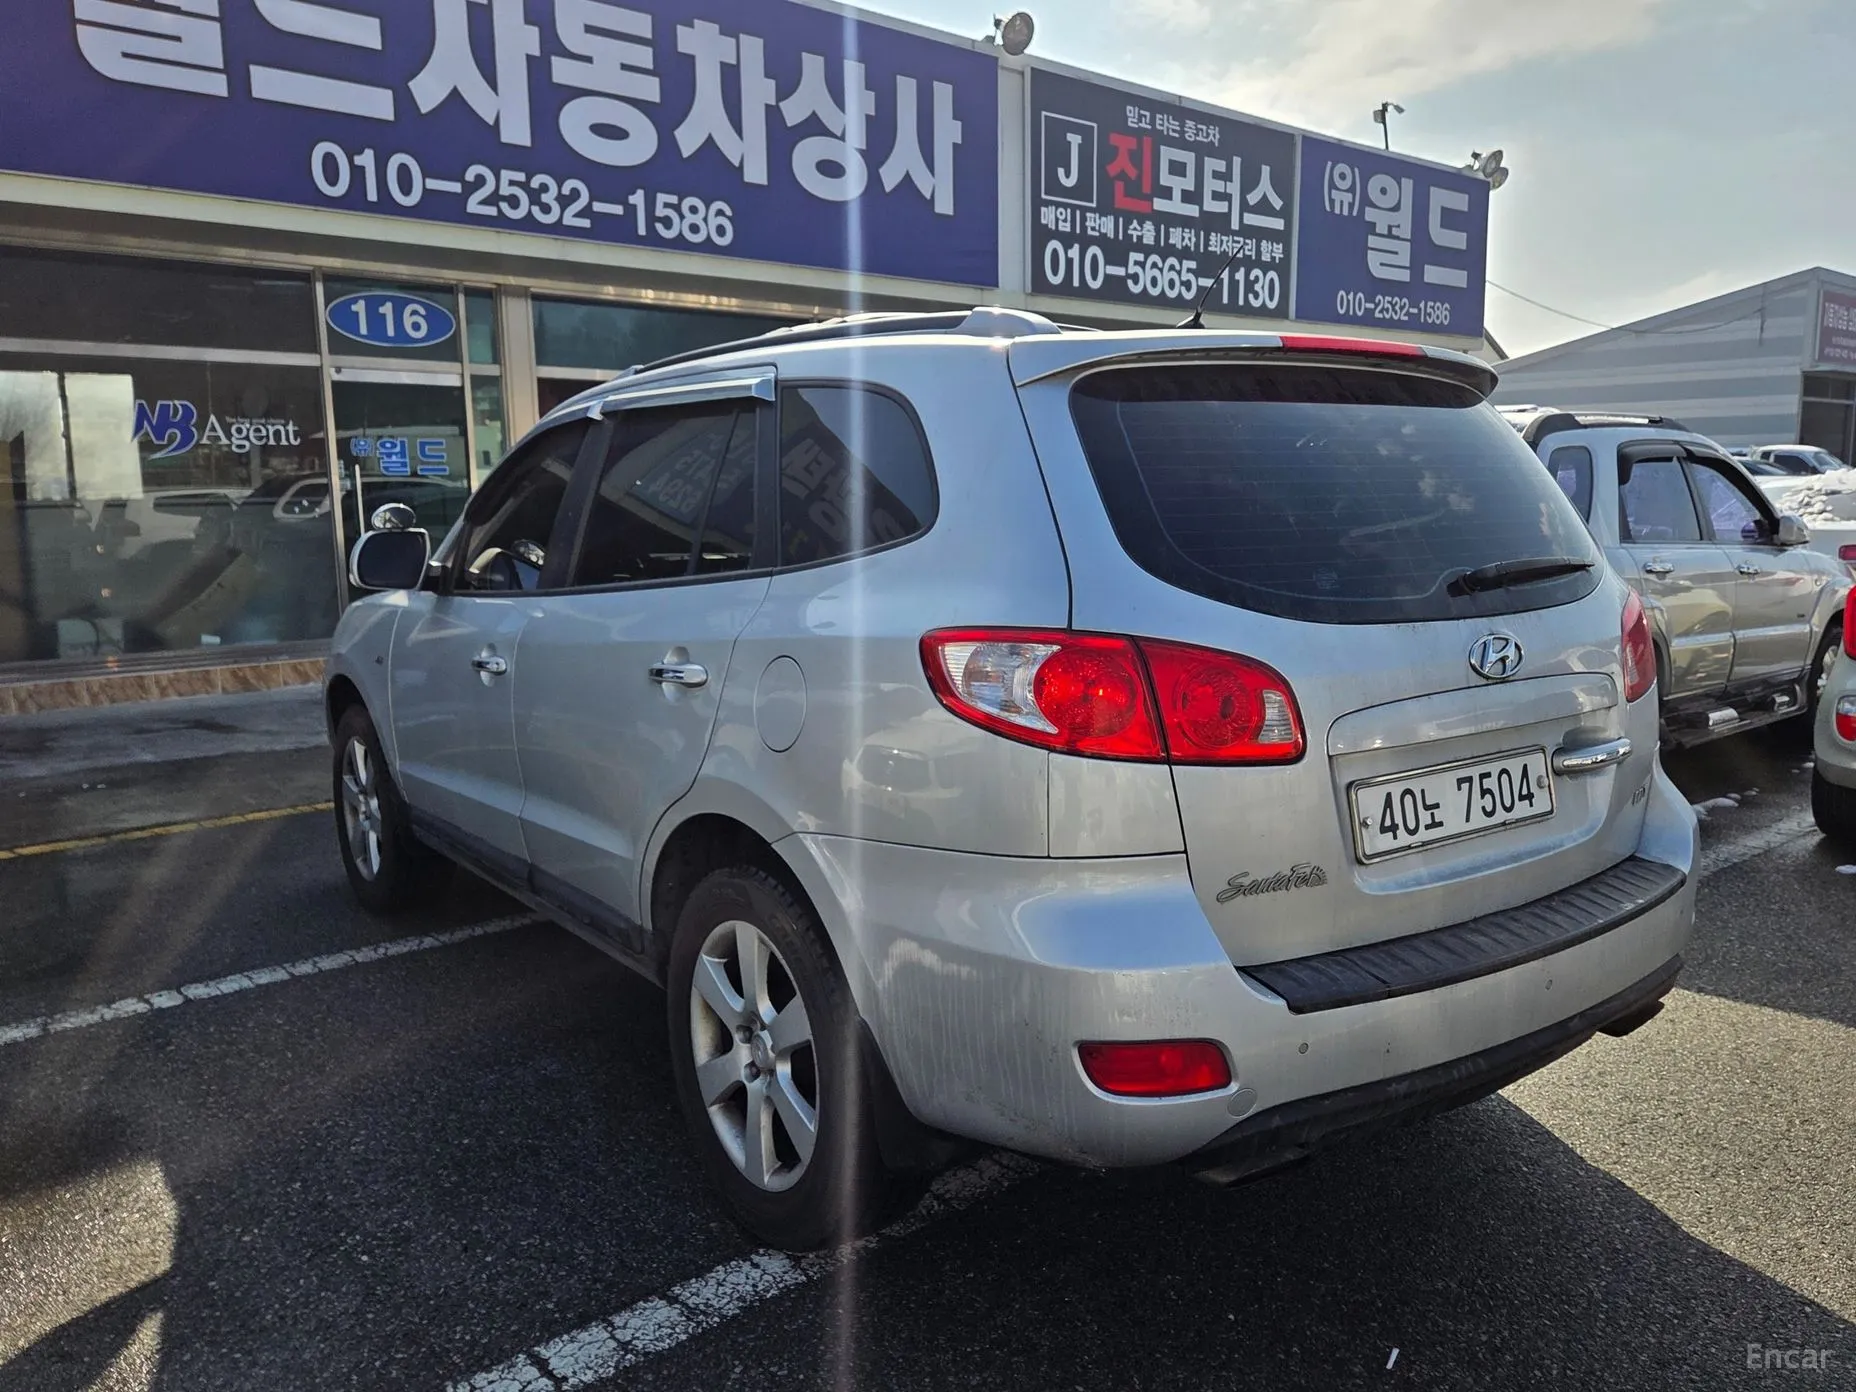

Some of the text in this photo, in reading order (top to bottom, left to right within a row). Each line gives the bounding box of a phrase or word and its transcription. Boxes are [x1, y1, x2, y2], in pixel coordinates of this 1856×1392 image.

[1126, 105, 1221, 147] 믿고 타는 중고차
[1057, 132, 1082, 188] J
[1105, 132, 1285, 230] 진모터스
[310, 141, 735, 248] 010-2532-1586
[1040, 205, 1071, 232] 매입
[1085, 211, 1115, 239] 판매
[1127, 218, 1157, 245] 수출
[1168, 226, 1197, 251] 폐차
[1260, 240, 1284, 264] 할부
[1044, 239, 1281, 310] 010-5665-1130
[351, 298, 428, 340] 116
[1336, 290, 1451, 326] 010-2532-1586
[199, 413, 301, 454] Agent
[1379, 763, 1536, 841] 40노 7504
